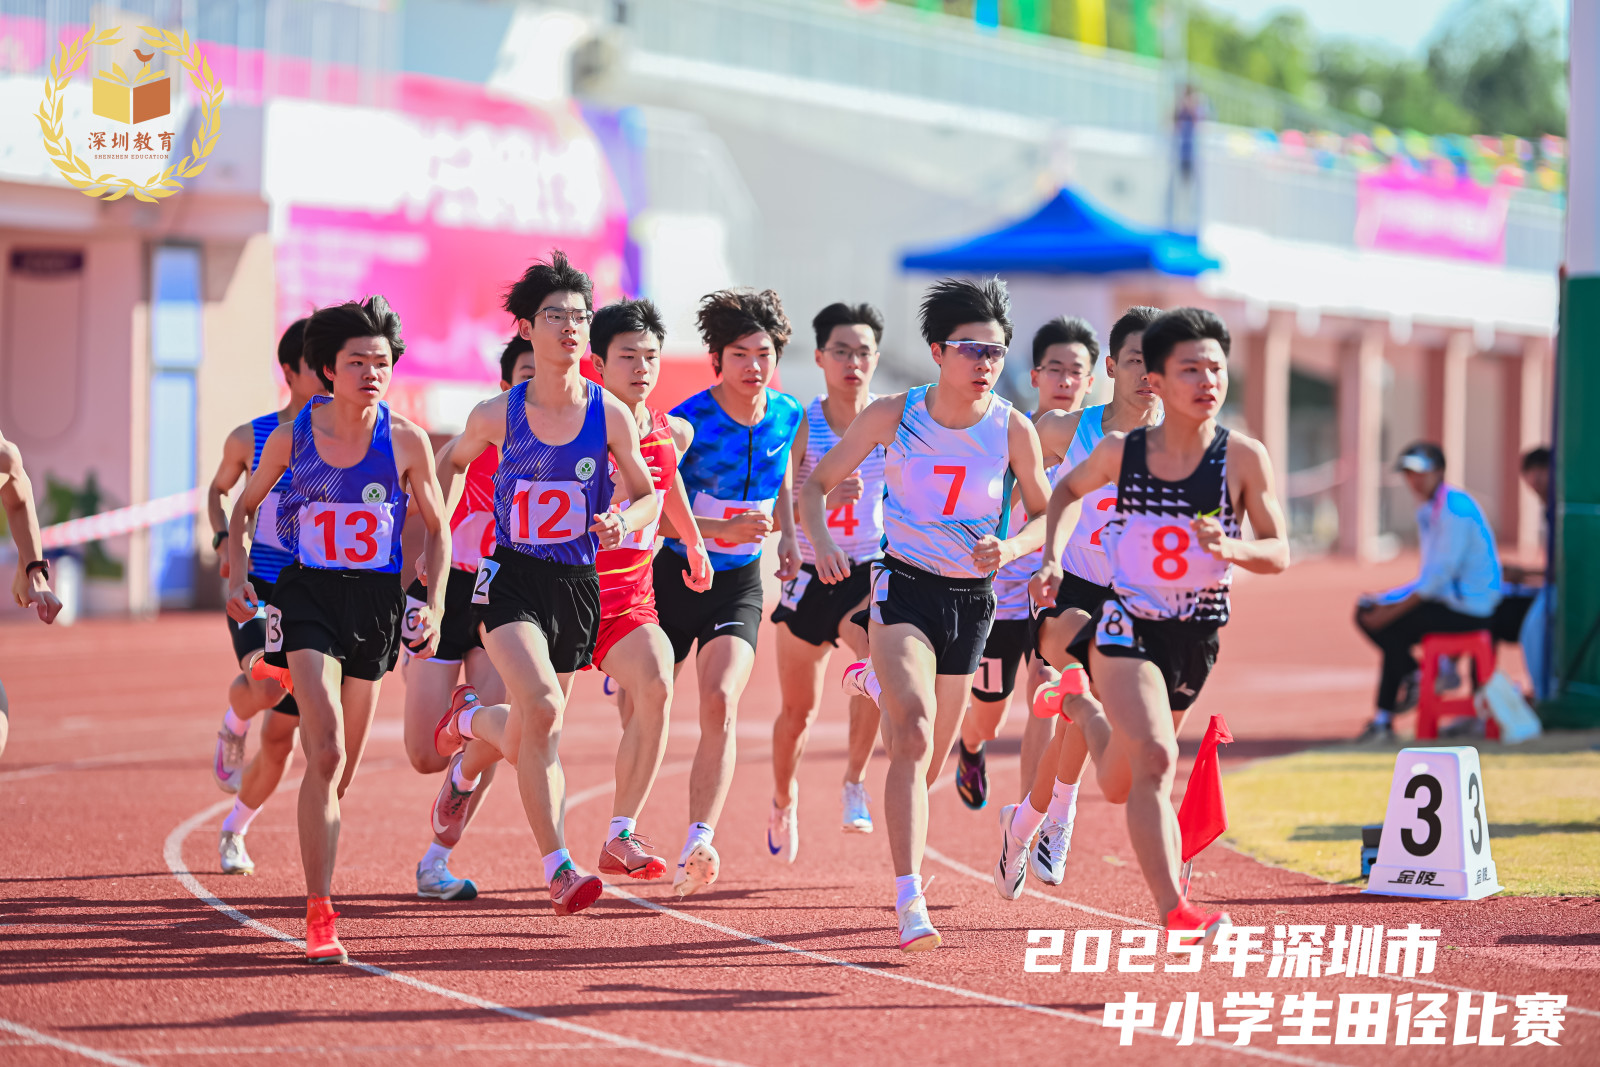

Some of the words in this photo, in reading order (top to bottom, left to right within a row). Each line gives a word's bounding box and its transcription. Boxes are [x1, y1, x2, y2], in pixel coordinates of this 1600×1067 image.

[933, 465, 967, 516] 7
[512, 489, 572, 539] 12
[827, 504, 859, 536] 4
[314, 510, 378, 563] 13
[1152, 525, 1190, 581] 8
[475, 567, 492, 596] 2
[784, 577, 799, 600] 4
[872, 566, 886, 601] 7
[1105, 610, 1124, 637] 8
[979, 661, 989, 690] 1
[1400, 773, 1443, 857] 3
[1468, 772, 1483, 855] 3
[1388, 869, 1445, 887] 金陵
